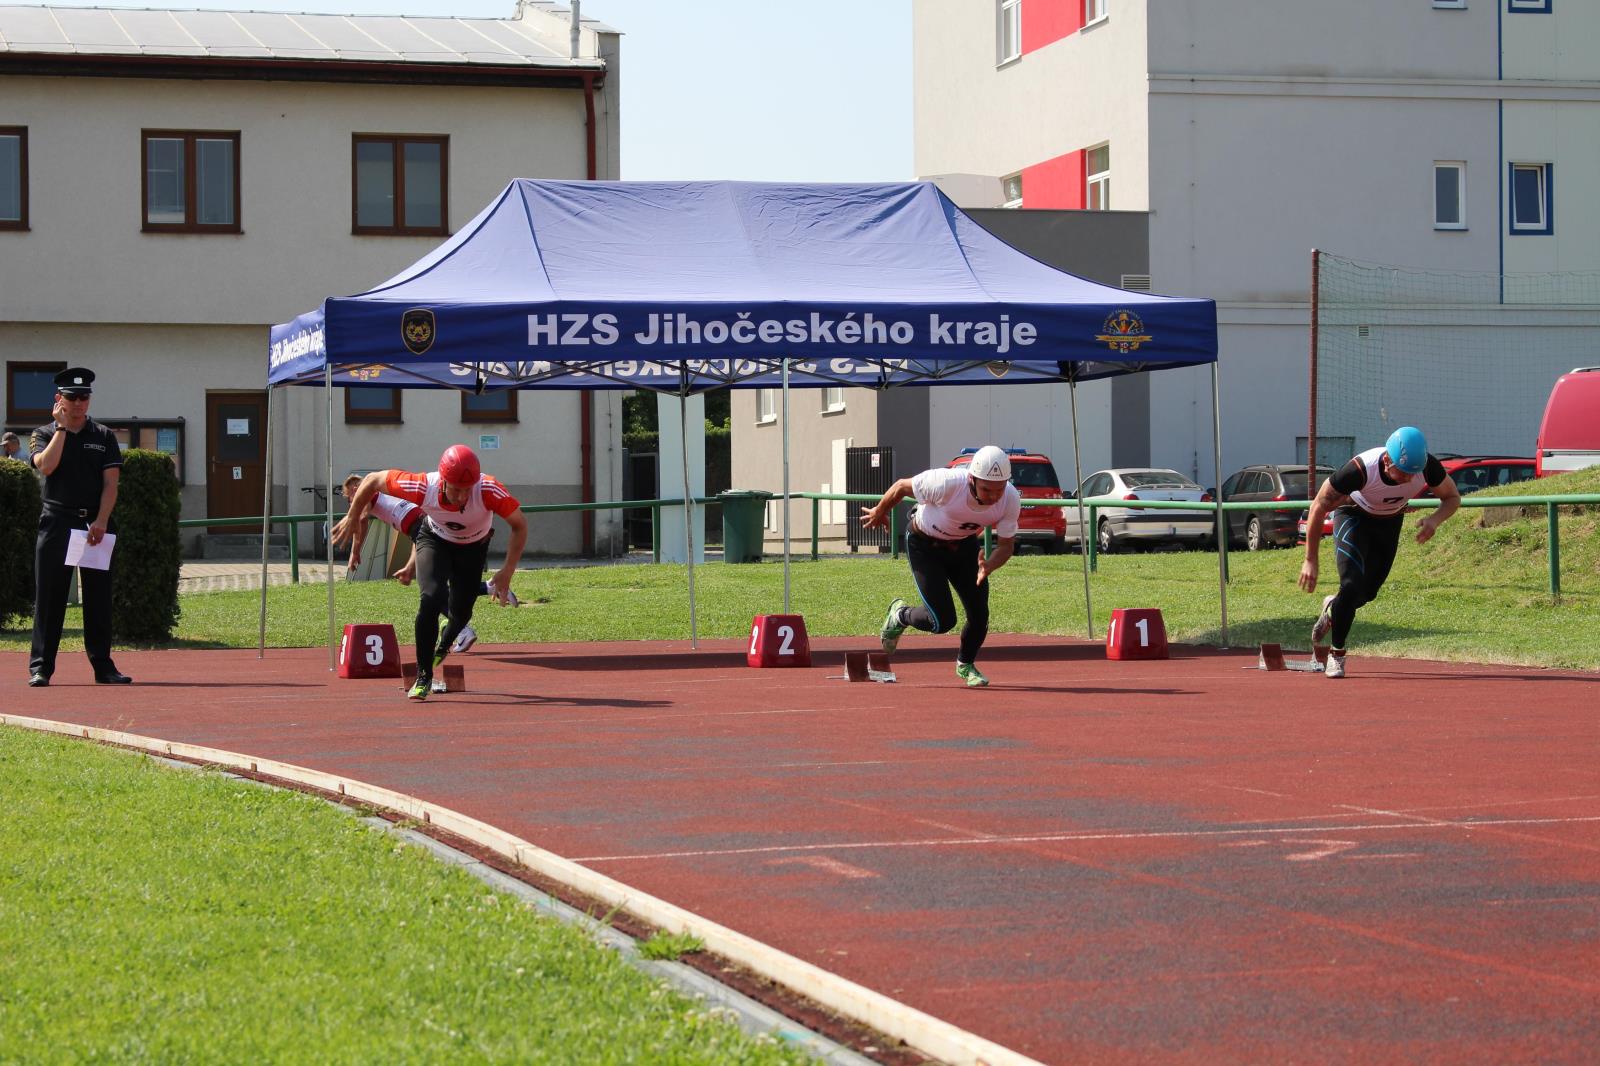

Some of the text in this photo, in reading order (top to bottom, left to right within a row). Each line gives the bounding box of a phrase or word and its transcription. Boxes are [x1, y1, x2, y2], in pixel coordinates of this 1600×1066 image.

[527, 311, 1038, 353] HZS Jihočeského kraje
[750, 625, 759, 655] 2
[777, 625, 795, 655] 2
[1110, 618, 1117, 647] 1
[1135, 618, 1149, 647] 1
[340, 634, 348, 665] 3
[365, 634, 384, 666] 3
